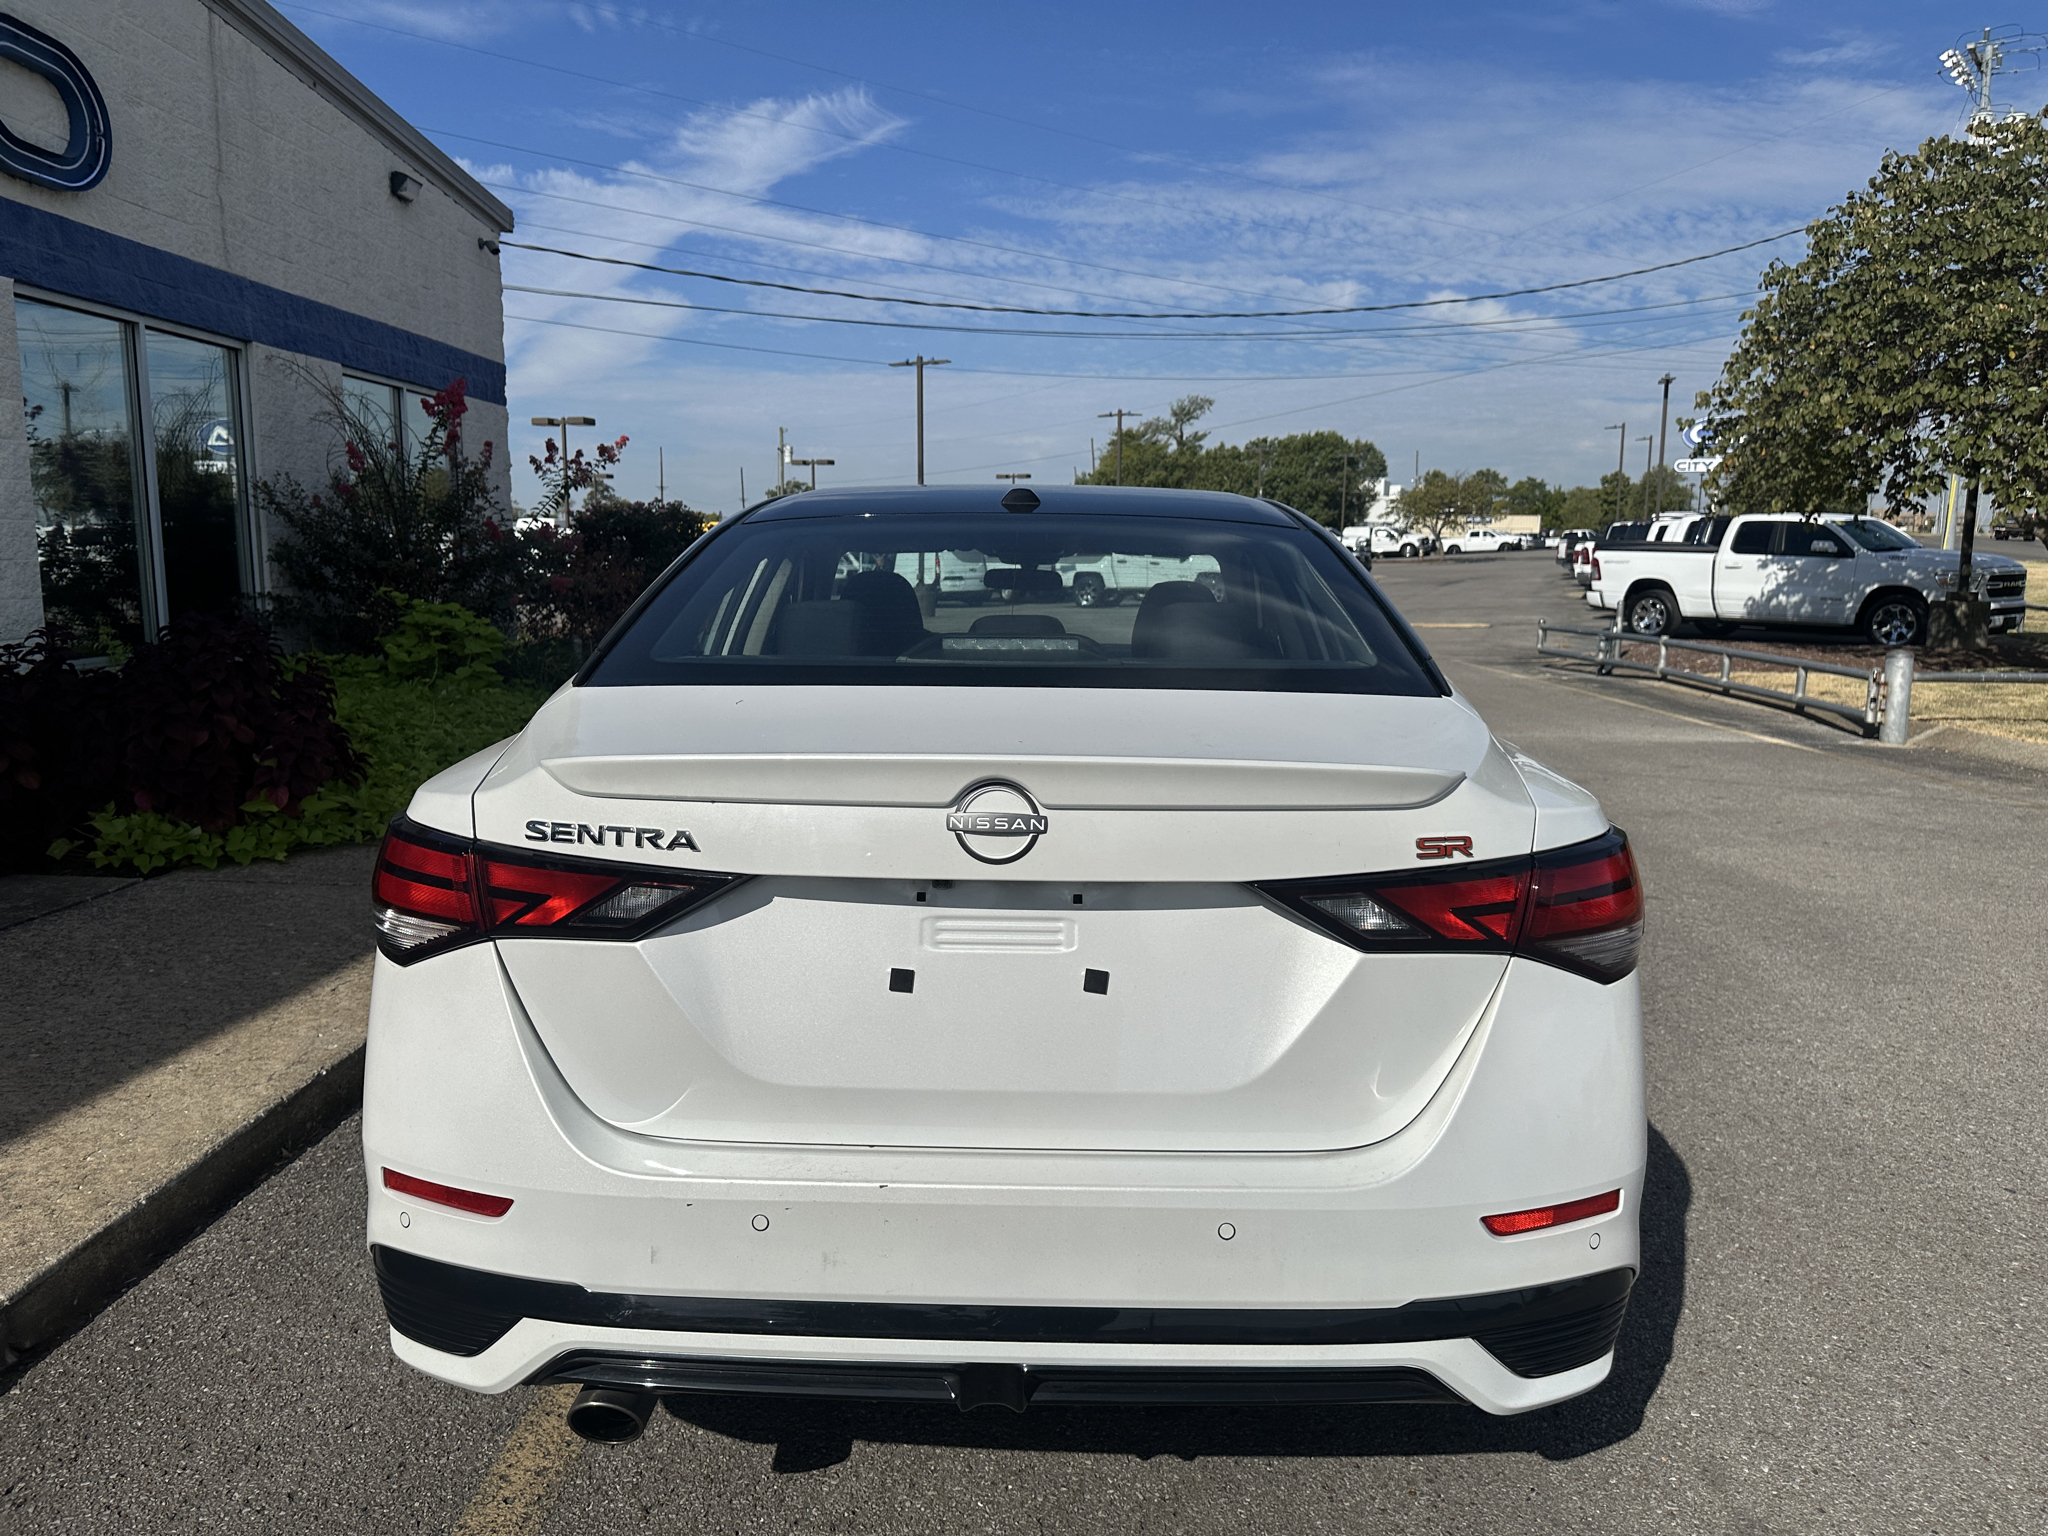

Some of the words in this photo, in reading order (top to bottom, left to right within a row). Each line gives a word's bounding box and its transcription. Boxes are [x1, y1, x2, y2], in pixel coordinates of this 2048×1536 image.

[1676, 461, 1713, 471] CITY
[949, 816, 1045, 831] NISSAN
[524, 819, 702, 853] SENTRA
[1416, 836, 1474, 860] SR
